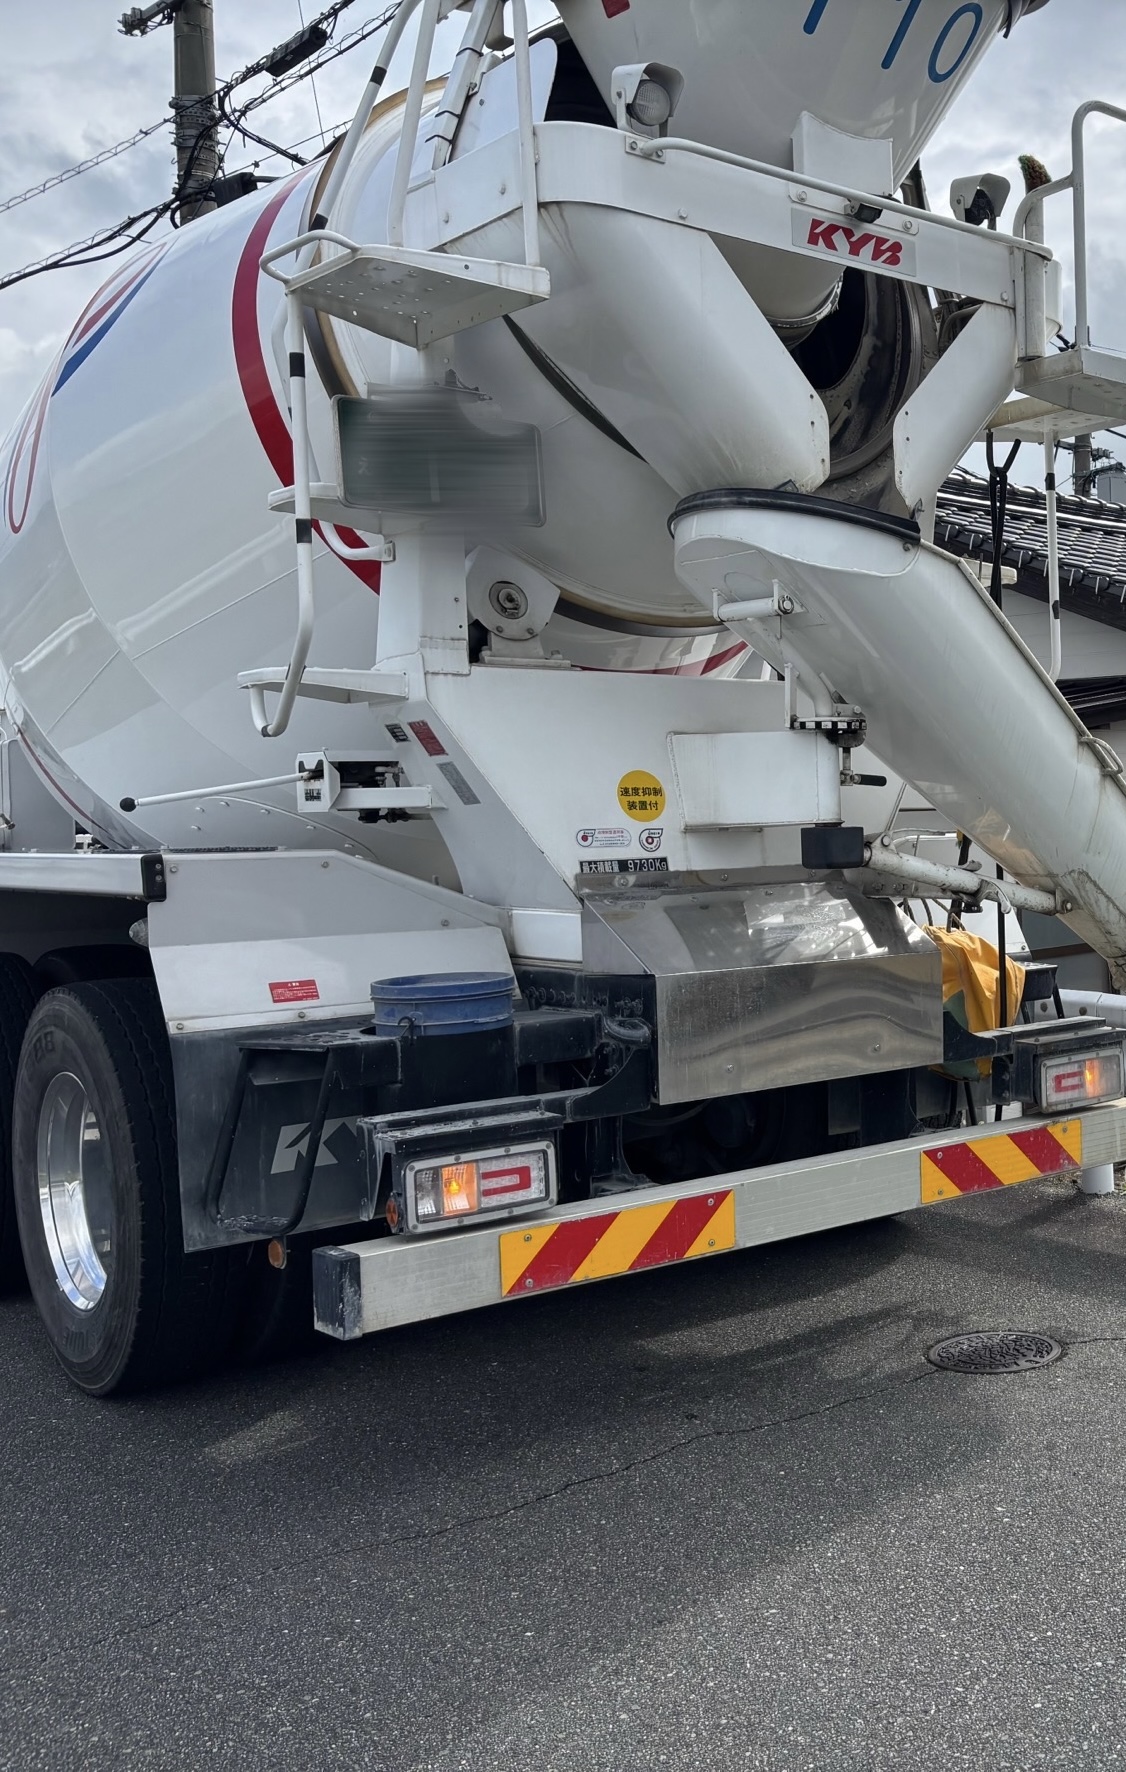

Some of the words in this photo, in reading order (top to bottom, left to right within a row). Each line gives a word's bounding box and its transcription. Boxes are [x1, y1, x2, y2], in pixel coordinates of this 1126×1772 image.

[807, 218, 902, 266] KYB
[620, 786, 663, 797] 速度抑制
[627, 800, 659, 811] 装置付
[628, 859, 667, 872] 9730Kg
